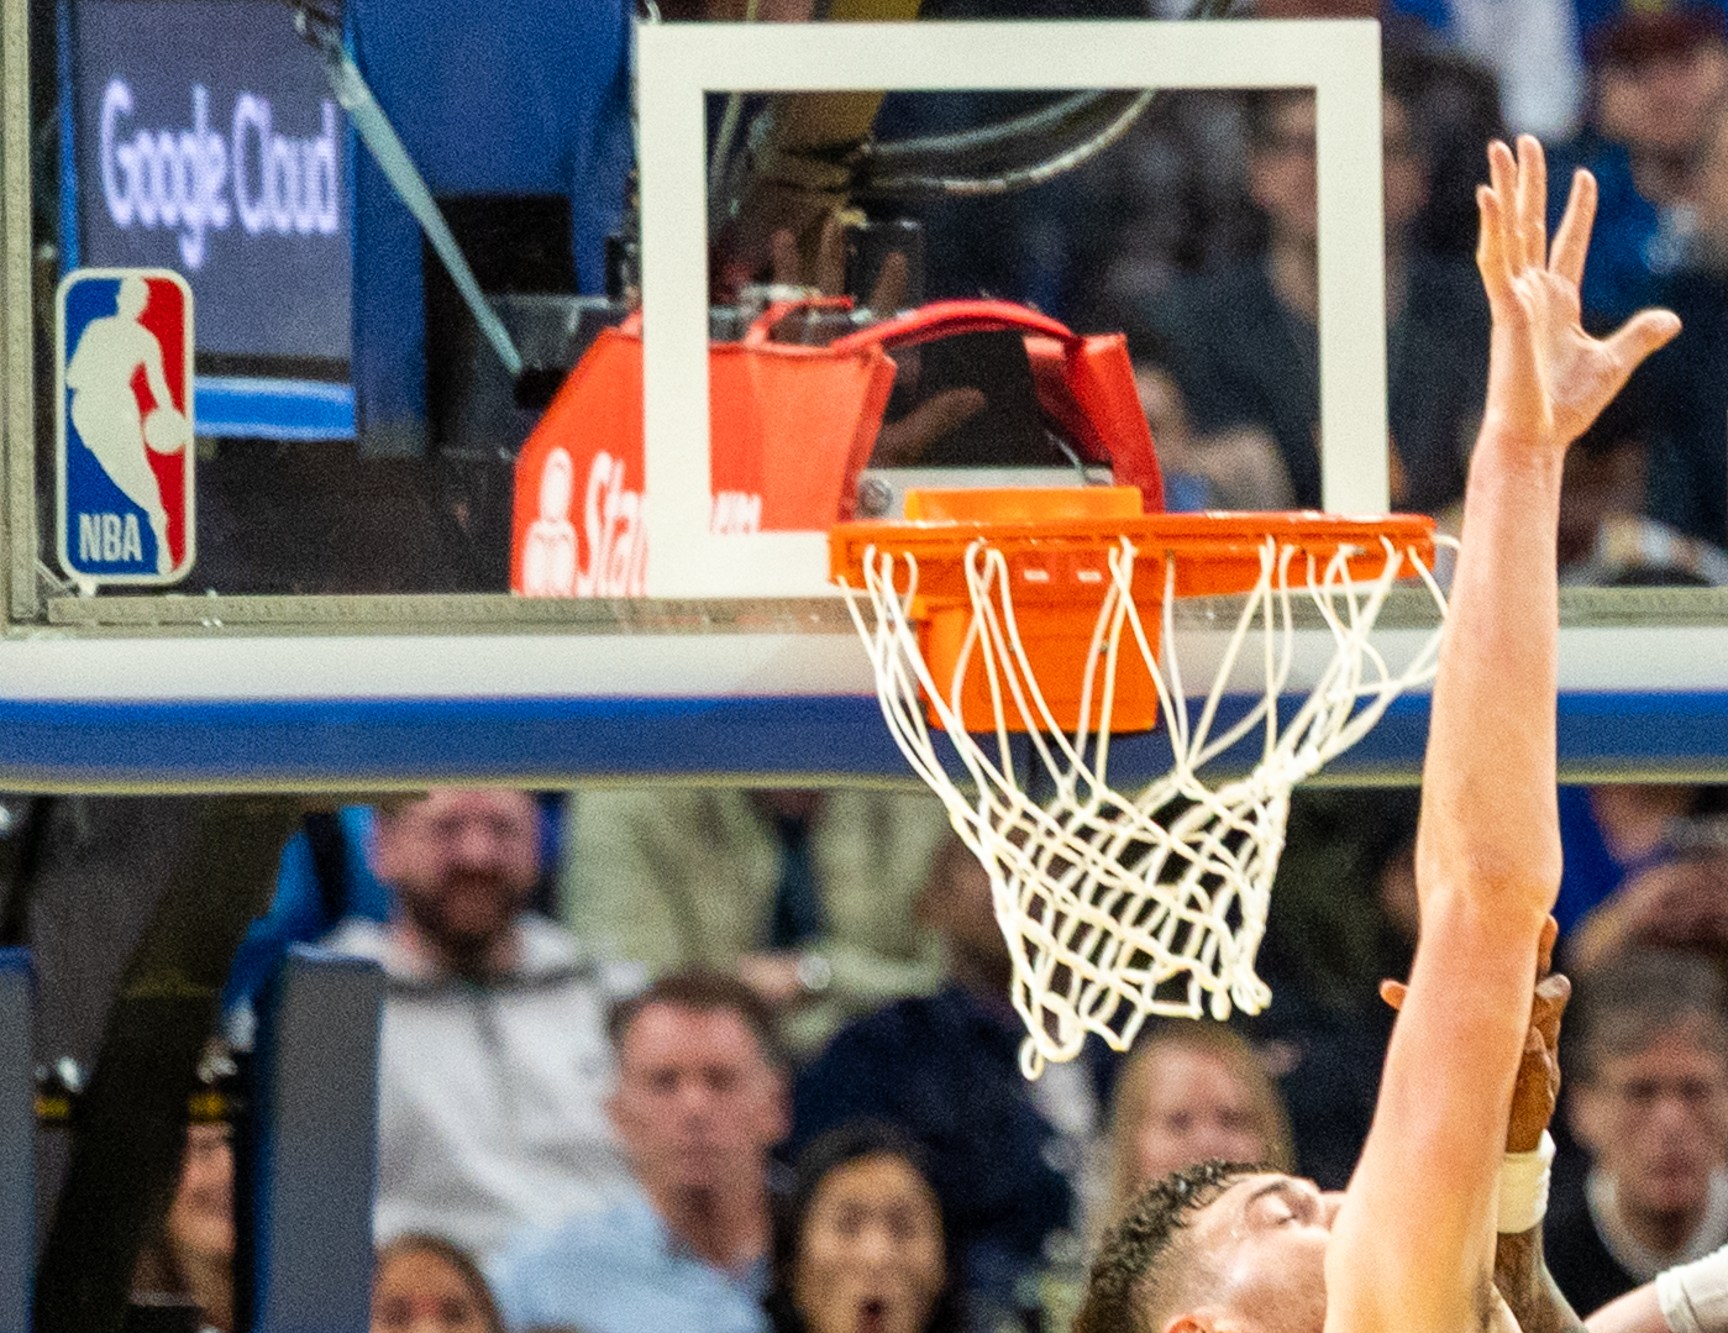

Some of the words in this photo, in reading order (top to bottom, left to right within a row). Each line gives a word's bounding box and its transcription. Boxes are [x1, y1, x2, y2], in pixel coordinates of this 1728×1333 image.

[101, 78, 232, 269] Google
[233, 93, 338, 234] Cloud
[79, 511, 143, 563] NBA
